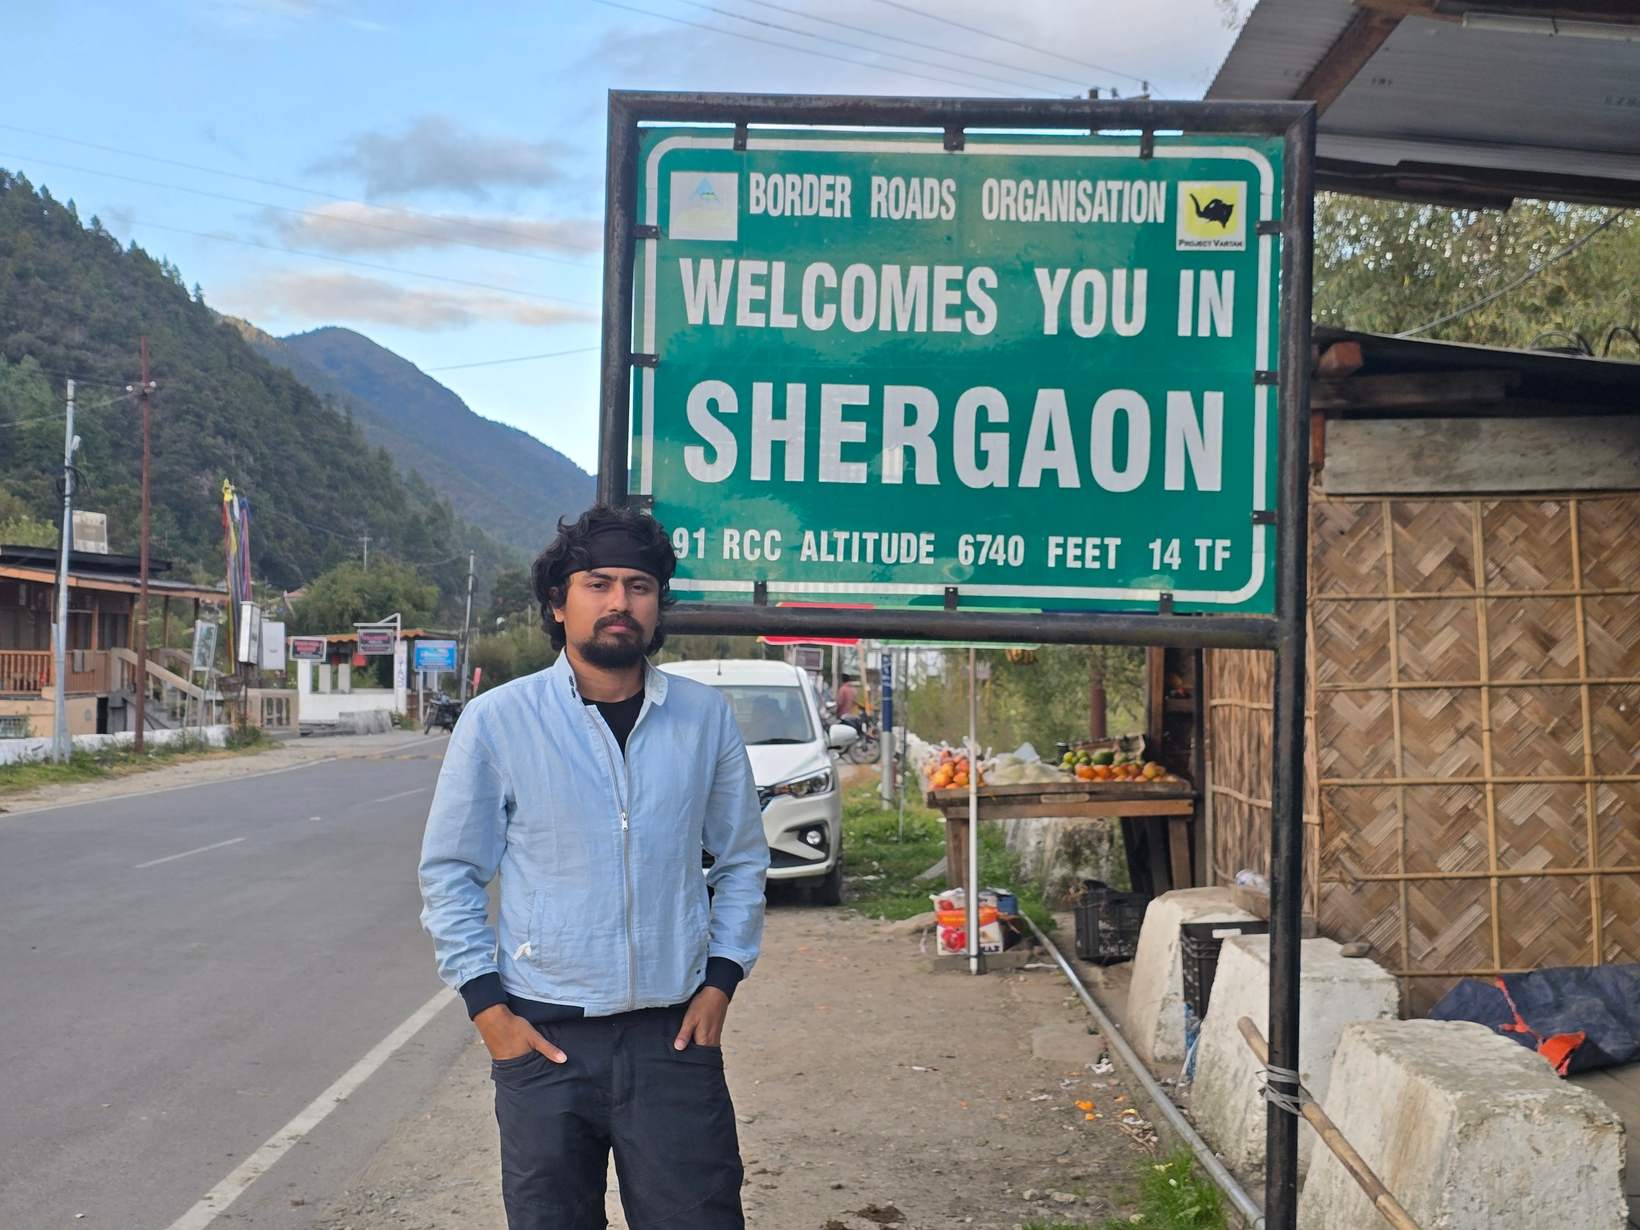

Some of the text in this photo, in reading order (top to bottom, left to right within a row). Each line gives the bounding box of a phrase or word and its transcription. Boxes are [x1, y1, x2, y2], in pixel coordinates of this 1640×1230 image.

[750, 172, 1167, 225] BORDER ROADS ORGANISATION
[679, 258, 1235, 338] WELCOMES YOU IN
[684, 380, 1224, 493] SHERGAON
[672, 527, 1232, 571] 91 RCC ALTITUDE 6740 FEET 14 TF
